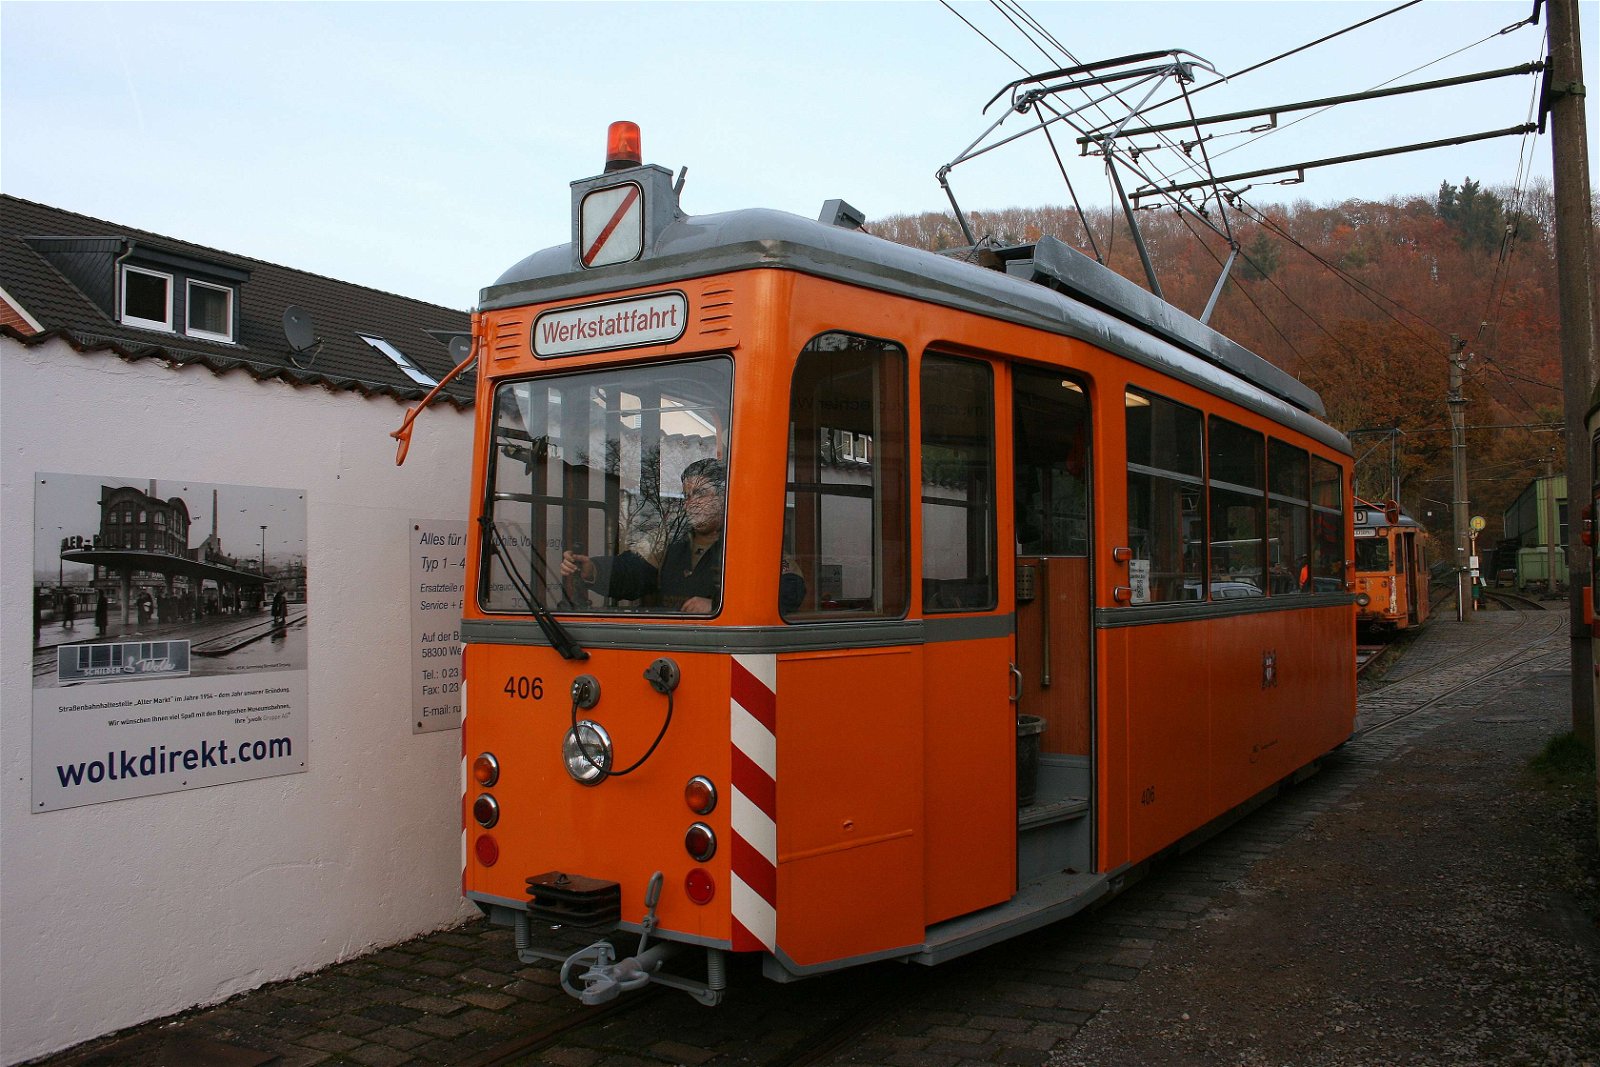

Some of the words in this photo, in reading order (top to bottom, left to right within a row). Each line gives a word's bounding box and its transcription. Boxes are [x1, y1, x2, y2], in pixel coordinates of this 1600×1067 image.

[542, 304, 677, 344] Werkstattfahrt
[1356, 511, 1364, 522] D
[420, 532, 445, 546] Alles
[448, 533, 462, 546] für
[421, 556, 439, 572] Typ
[443, 557, 448, 569] 1
[420, 583, 458, 593] Ersatzteile
[420, 600, 449, 610] Service
[421, 631, 436, 642] Auf
[438, 631, 451, 642] der
[422, 647, 448, 658] 58300
[449, 646, 462, 656] We
[422, 685, 440, 695] Fax:
[504, 675, 544, 700] 406
[423, 704, 451, 717] E-mail:
[56, 736, 293, 788] wolkdirekt.com
[1141, 784, 1155, 807] 406
